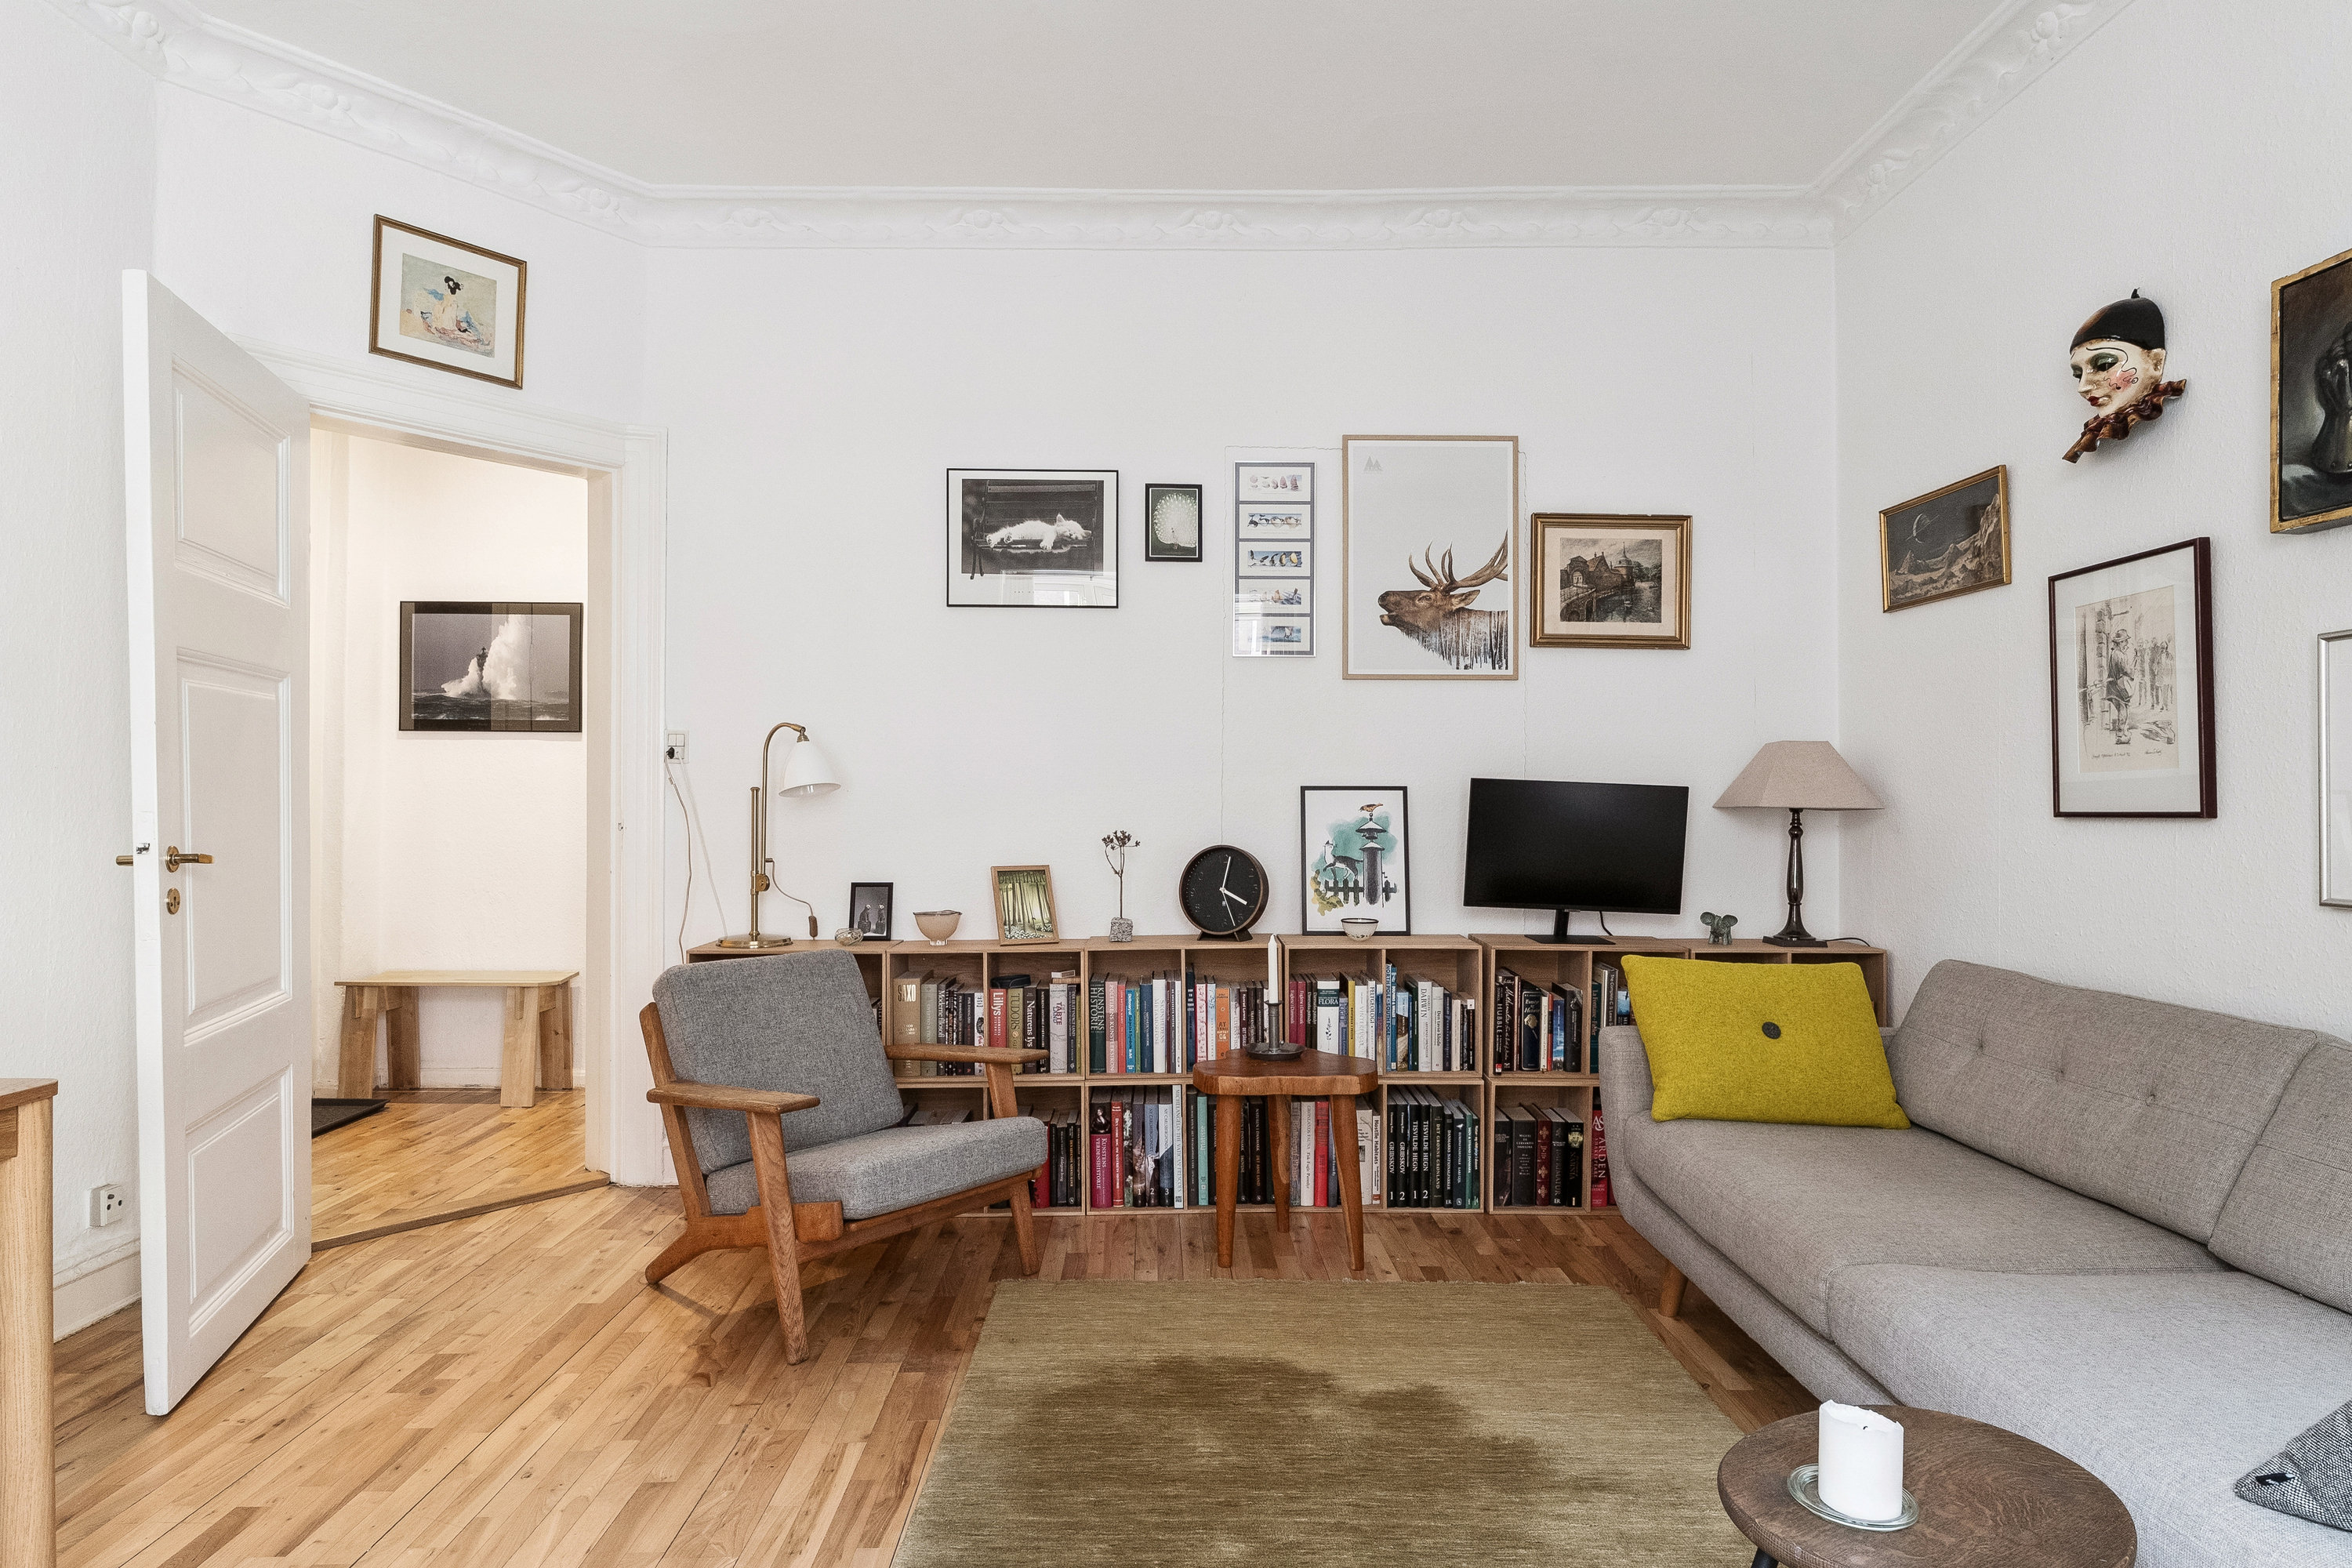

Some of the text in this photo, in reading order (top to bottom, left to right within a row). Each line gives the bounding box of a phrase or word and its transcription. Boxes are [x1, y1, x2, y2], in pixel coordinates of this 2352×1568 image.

[898, 985, 916, 1002] SAXO
[992, 993, 1004, 1015] Lillys
[1011, 993, 1020, 1029] TUDORS
[1025, 1036, 1035, 1047] lys
[1399, 1192, 1405, 1200] 2
[1423, 1190, 1428, 1199] 2
